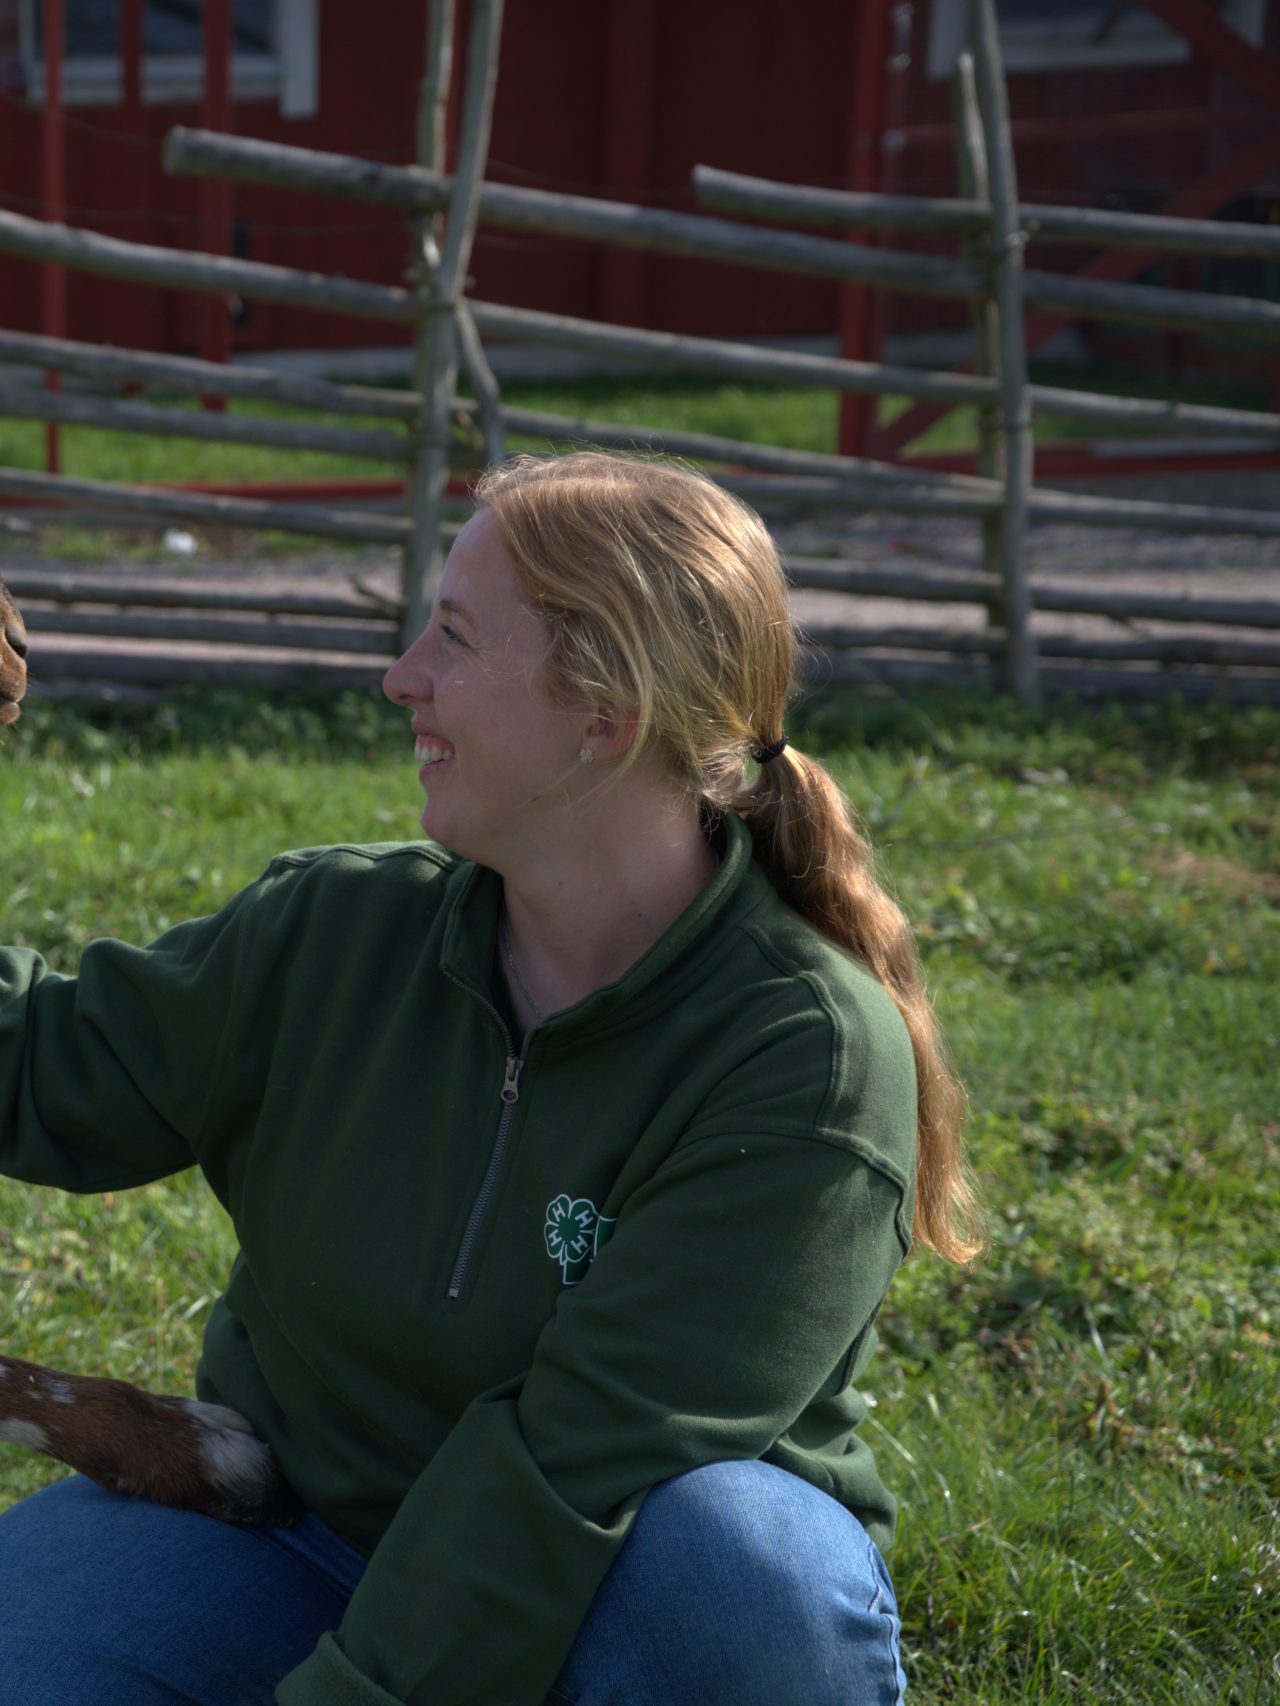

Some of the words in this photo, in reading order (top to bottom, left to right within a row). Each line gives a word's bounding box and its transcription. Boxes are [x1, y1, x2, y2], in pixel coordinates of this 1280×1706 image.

[552, 1202, 566, 1222] H
[575, 1209, 594, 1228] H
[548, 1229, 562, 1247] H
[570, 1235, 589, 1254] H
